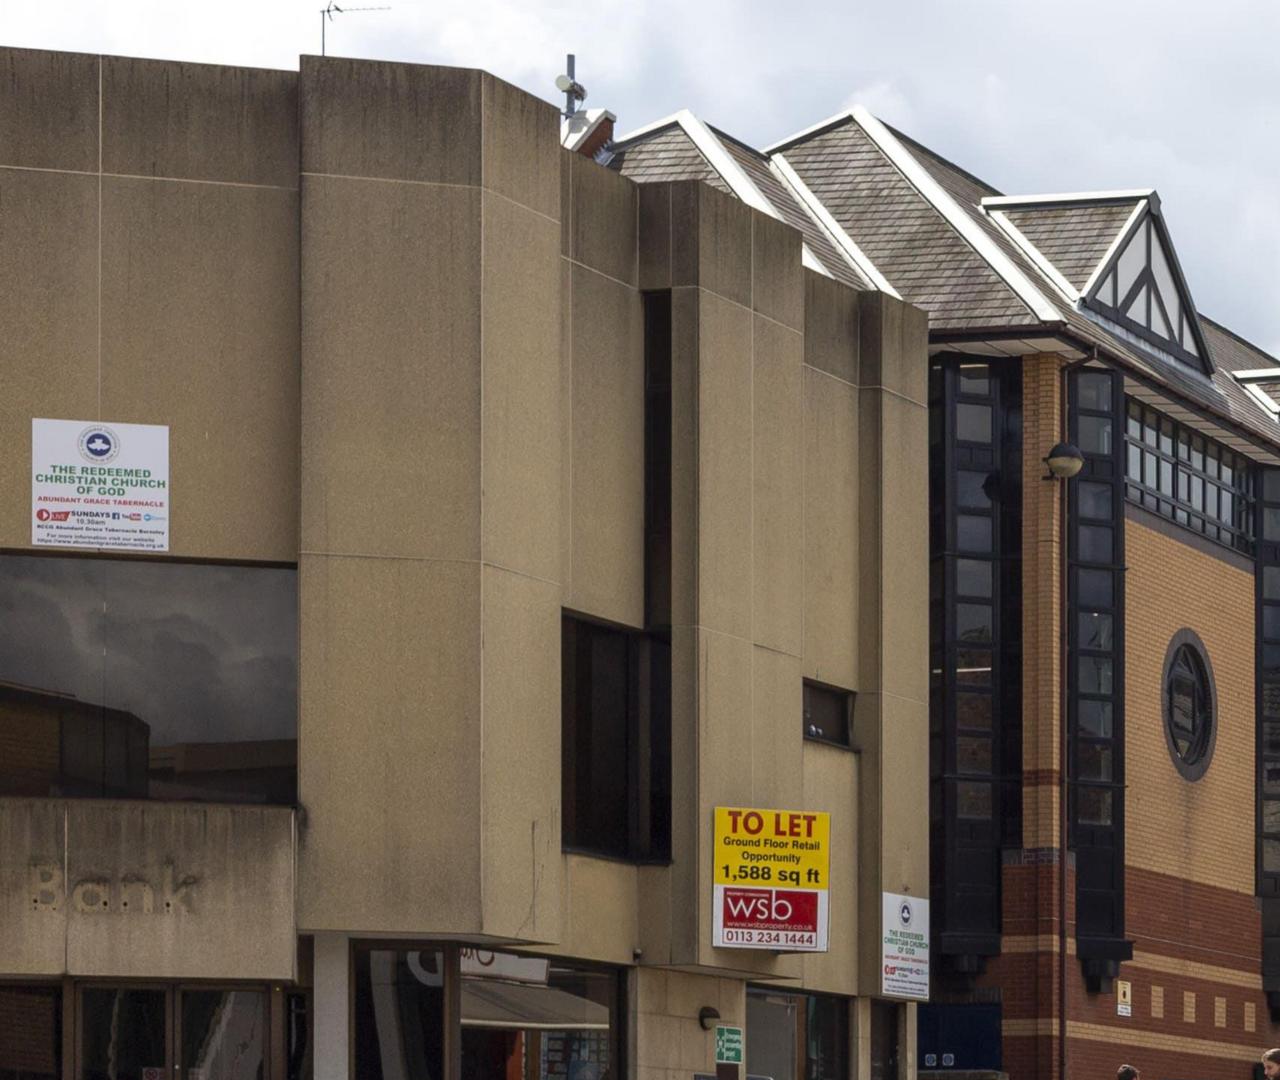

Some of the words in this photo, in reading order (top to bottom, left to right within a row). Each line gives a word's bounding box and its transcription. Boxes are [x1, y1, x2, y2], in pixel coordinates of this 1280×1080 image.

[50, 464, 76, 474] THE
[81, 466, 151, 478] REDEEMED
[35, 474, 107, 486] CHRISTIAN
[111, 477, 166, 488] CHURCH
[77, 486, 93, 495] OF
[97, 487, 125, 496] GOD
[37, 496, 81, 504] ABUNDANT
[83, 497, 111, 505] GRACE
[113, 499, 164, 507] TABERNACLE
[71, 510, 111, 518] SUNDAYS
[728, 811, 764, 835] TO
[774, 813, 817, 838] LET
[723, 836, 761, 848] Ground
[763, 838, 790, 849] Floor
[792, 840, 820, 850] Retail
[741, 851, 801, 865] Opportunity
[722, 864, 772, 882] 1,588
[777, 870, 801, 886] sq
[806, 868, 820, 884] ft
[727, 888, 792, 920] wsb
[726, 930, 753, 942] 0113
[757, 932, 780, 943] 234
[784, 933, 813, 944] 1444
